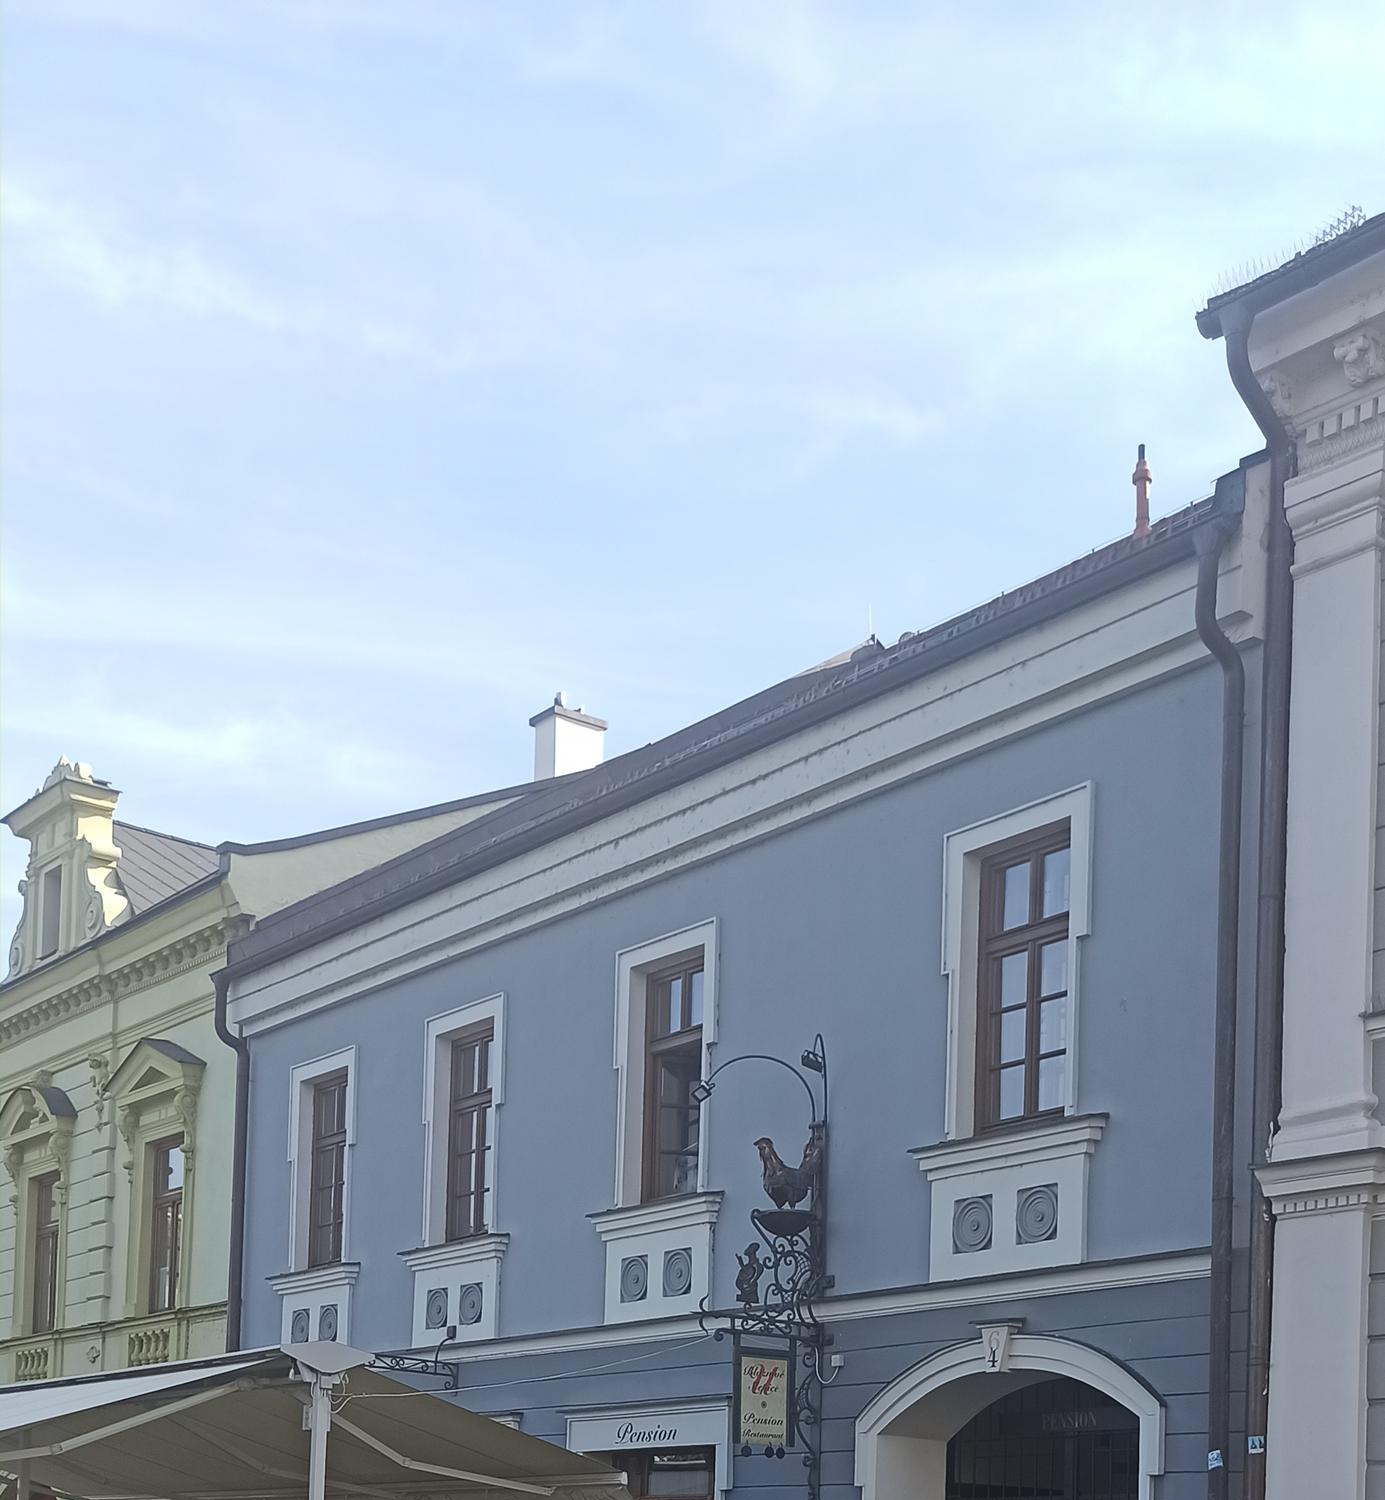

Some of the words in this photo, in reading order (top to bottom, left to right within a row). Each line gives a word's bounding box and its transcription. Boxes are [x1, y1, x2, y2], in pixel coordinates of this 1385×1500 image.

[743, 1412, 784, 1426] Pension
[1041, 1410, 1097, 1431] PENSION
[614, 1422, 678, 1444] Pension
[743, 1429, 784, 1439] Restaurant
